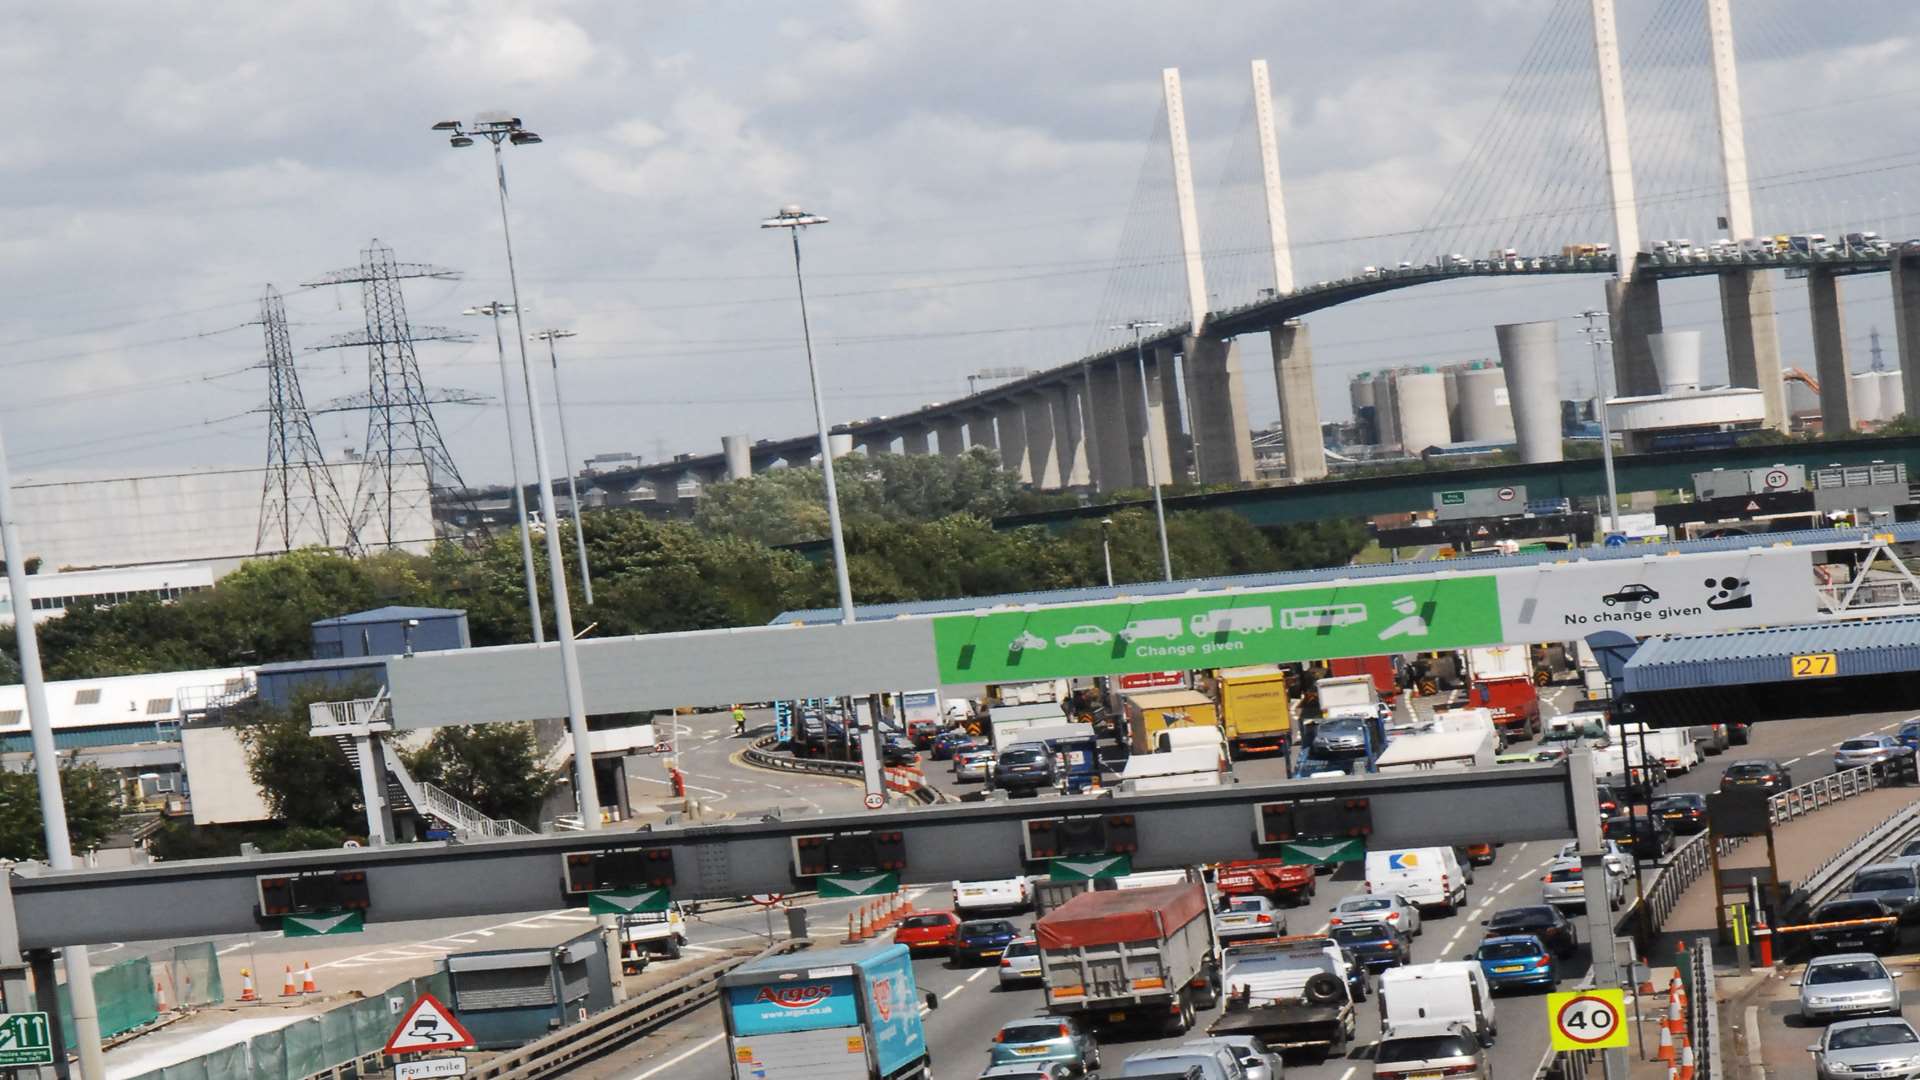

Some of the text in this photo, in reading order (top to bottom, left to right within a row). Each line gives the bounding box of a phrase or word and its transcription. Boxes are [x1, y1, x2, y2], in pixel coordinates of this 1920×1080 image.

[1564, 606, 1702, 625] No change given
[1136, 640, 1244, 657] Change given
[1796, 657, 1830, 675] 27
[755, 984, 833, 1007] Argos
[1567, 1009, 1611, 1030] 40
[401, 1067, 419, 1075] For
[435, 1062, 460, 1072] mile
